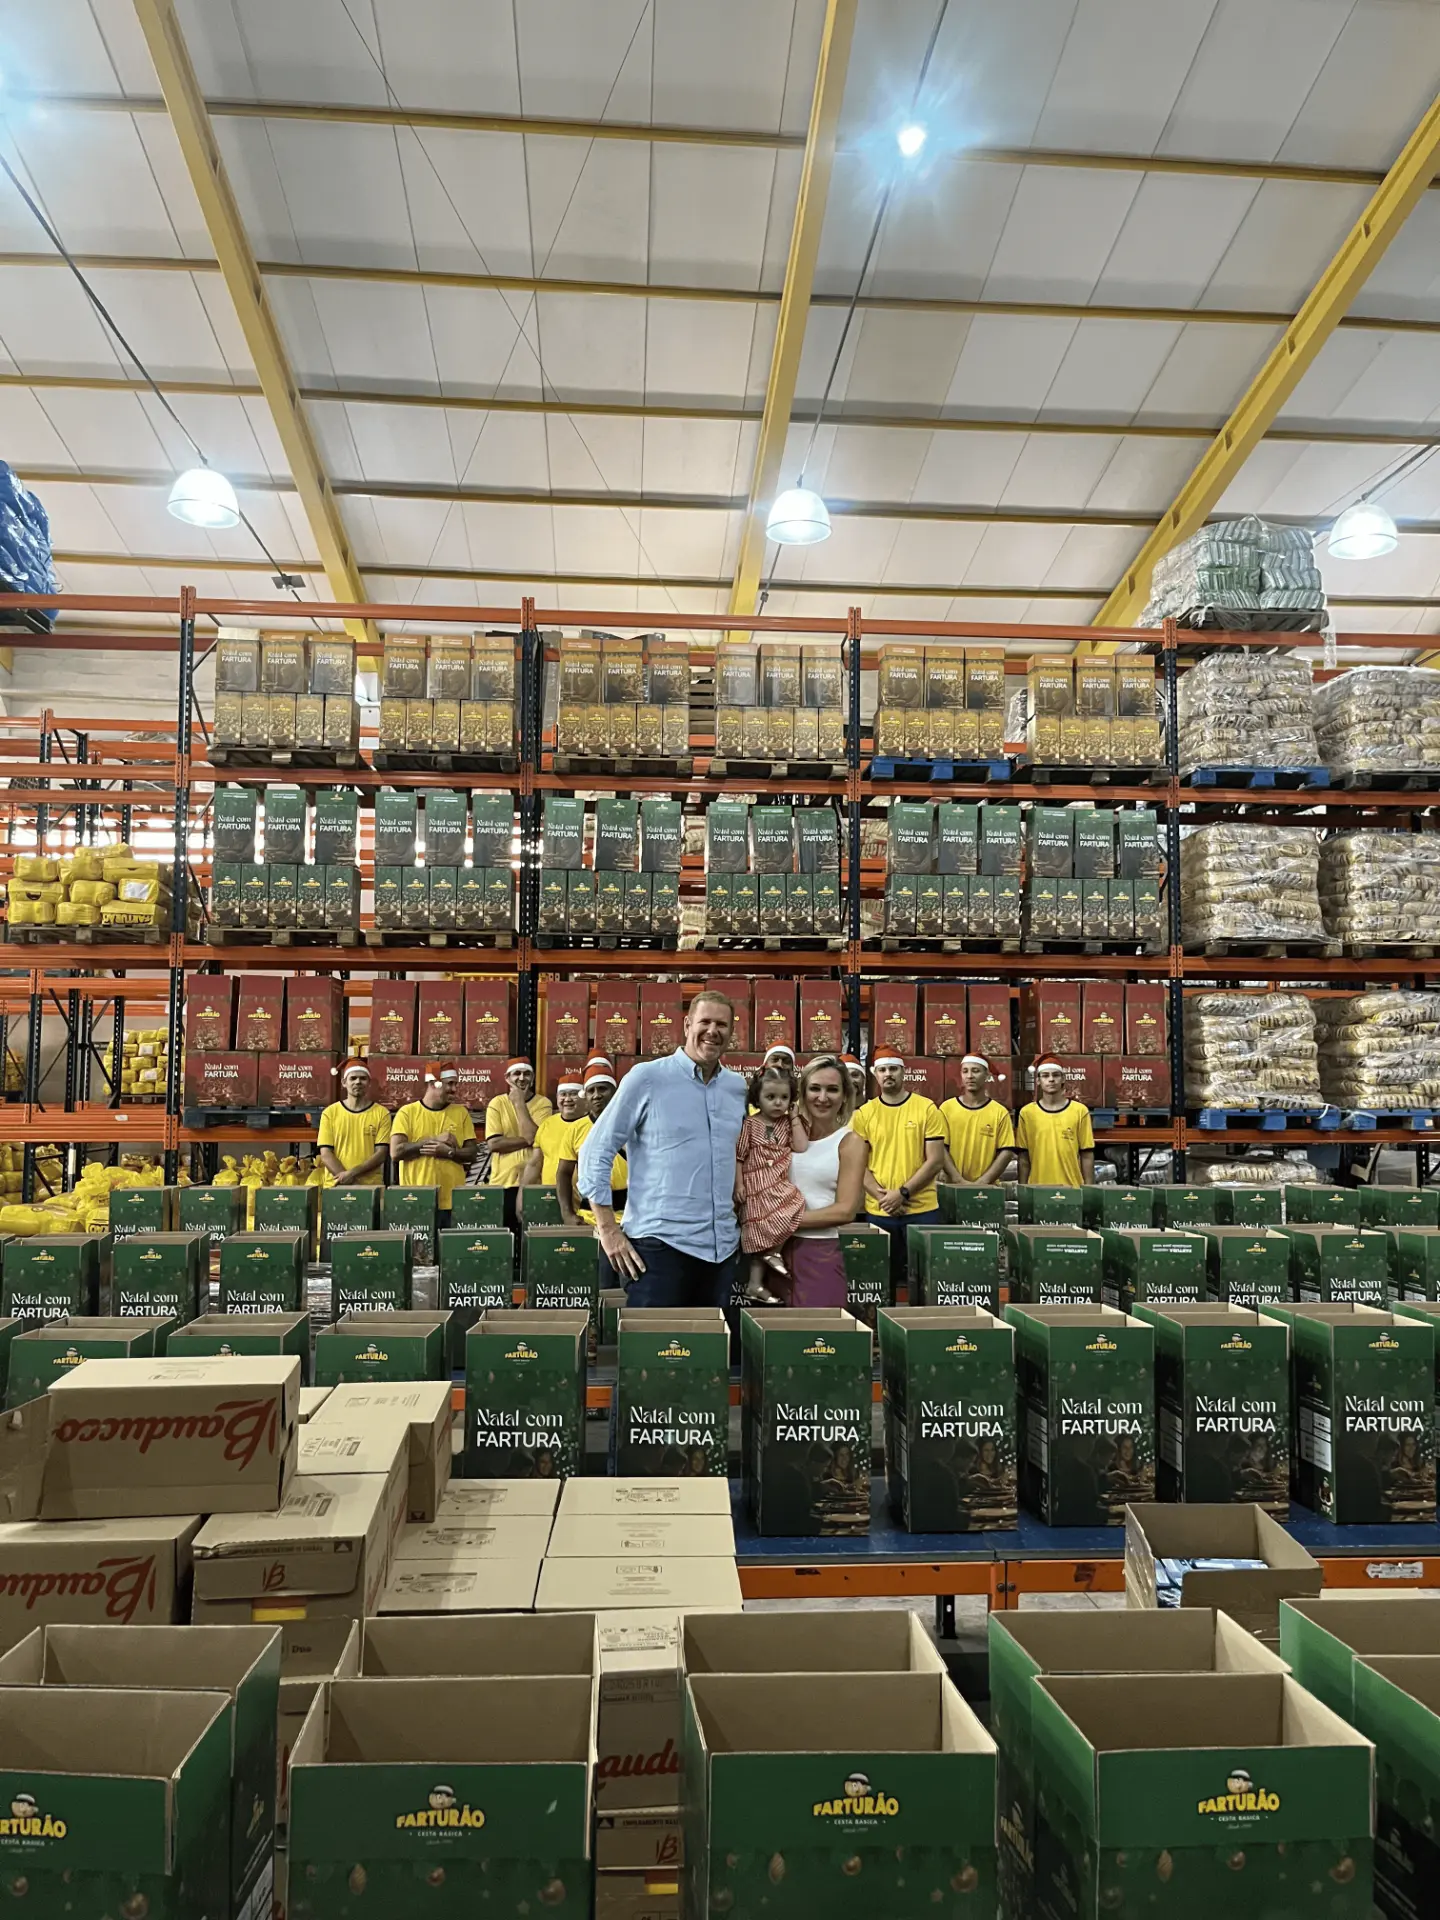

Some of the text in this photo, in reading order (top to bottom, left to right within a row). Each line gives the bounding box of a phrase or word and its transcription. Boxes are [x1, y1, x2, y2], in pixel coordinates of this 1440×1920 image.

[218, 823, 251, 831] FARTURA
[268, 823, 300, 831] FARTURA
[547, 830, 579, 838] FARTURA
[601, 831, 633, 839] FARTURA
[898, 836, 928, 844] FARTURA
[943, 836, 973, 844] FARTURA
[386, 1066, 403, 1074] Natal
[449, 1283, 504, 1293] Natal com
[536, 1284, 591, 1294] Natal com
[937, 1281, 991, 1293] Natal com
[1040, 1283, 1094, 1294] Natal com
[1147, 1283, 1198, 1294] Natal com
[1229, 1282, 1281, 1293] Natal com
[1330, 1278, 1381, 1289] Natal com
[12, 1293, 71, 1305] Natal com
[120, 1292, 178, 1303] Natal com
[227, 1290, 284, 1301] Natal com
[339, 1289, 395, 1299] Natal com
[848, 1292, 881, 1303] RTURA
[1229, 1295, 1280, 1304] FARTURA
[1331, 1291, 1381, 1301] FARTURA
[449, 1296, 504, 1307] FARTURA
[536, 1297, 589, 1307] FARTURA
[937, 1295, 991, 1305] FARTURA
[1040, 1296, 1092, 1304] FARTURA
[120, 1305, 177, 1316] FARTURA
[227, 1304, 283, 1314] FARTURA
[339, 1302, 395, 1312] FARTURA
[11, 1308, 69, 1318] FARTURA
[53, 1356, 87, 1364] FARTURÃ
[921, 1401, 1004, 1417] Natal com
[1062, 1398, 1142, 1414] Natal com
[1196, 1396, 1276, 1412] Natal com
[1345, 1396, 1424, 1412] Natal com
[630, 1406, 715, 1425] Natal com
[777, 1403, 860, 1420] Natal com
[477, 1409, 563, 1427] Natal com
[921, 1422, 1003, 1437] FARTURA
[1062, 1420, 1142, 1434] FARTURA
[1196, 1418, 1275, 1432] FARTURA
[1345, 1417, 1424, 1432] FARTURA
[56, 1397, 277, 1471] Bauducco
[630, 1429, 714, 1445] FARTURA
[776, 1426, 858, 1441] FARTURA
[477, 1431, 561, 1448] FARTURA
[813, 1792, 899, 1816] FARTURÃO
[1198, 1788, 1280, 1814] FARTURÃO
[396, 1804, 484, 1828] FARTURÃO
[0, 1814, 67, 1838] RTURÃO
